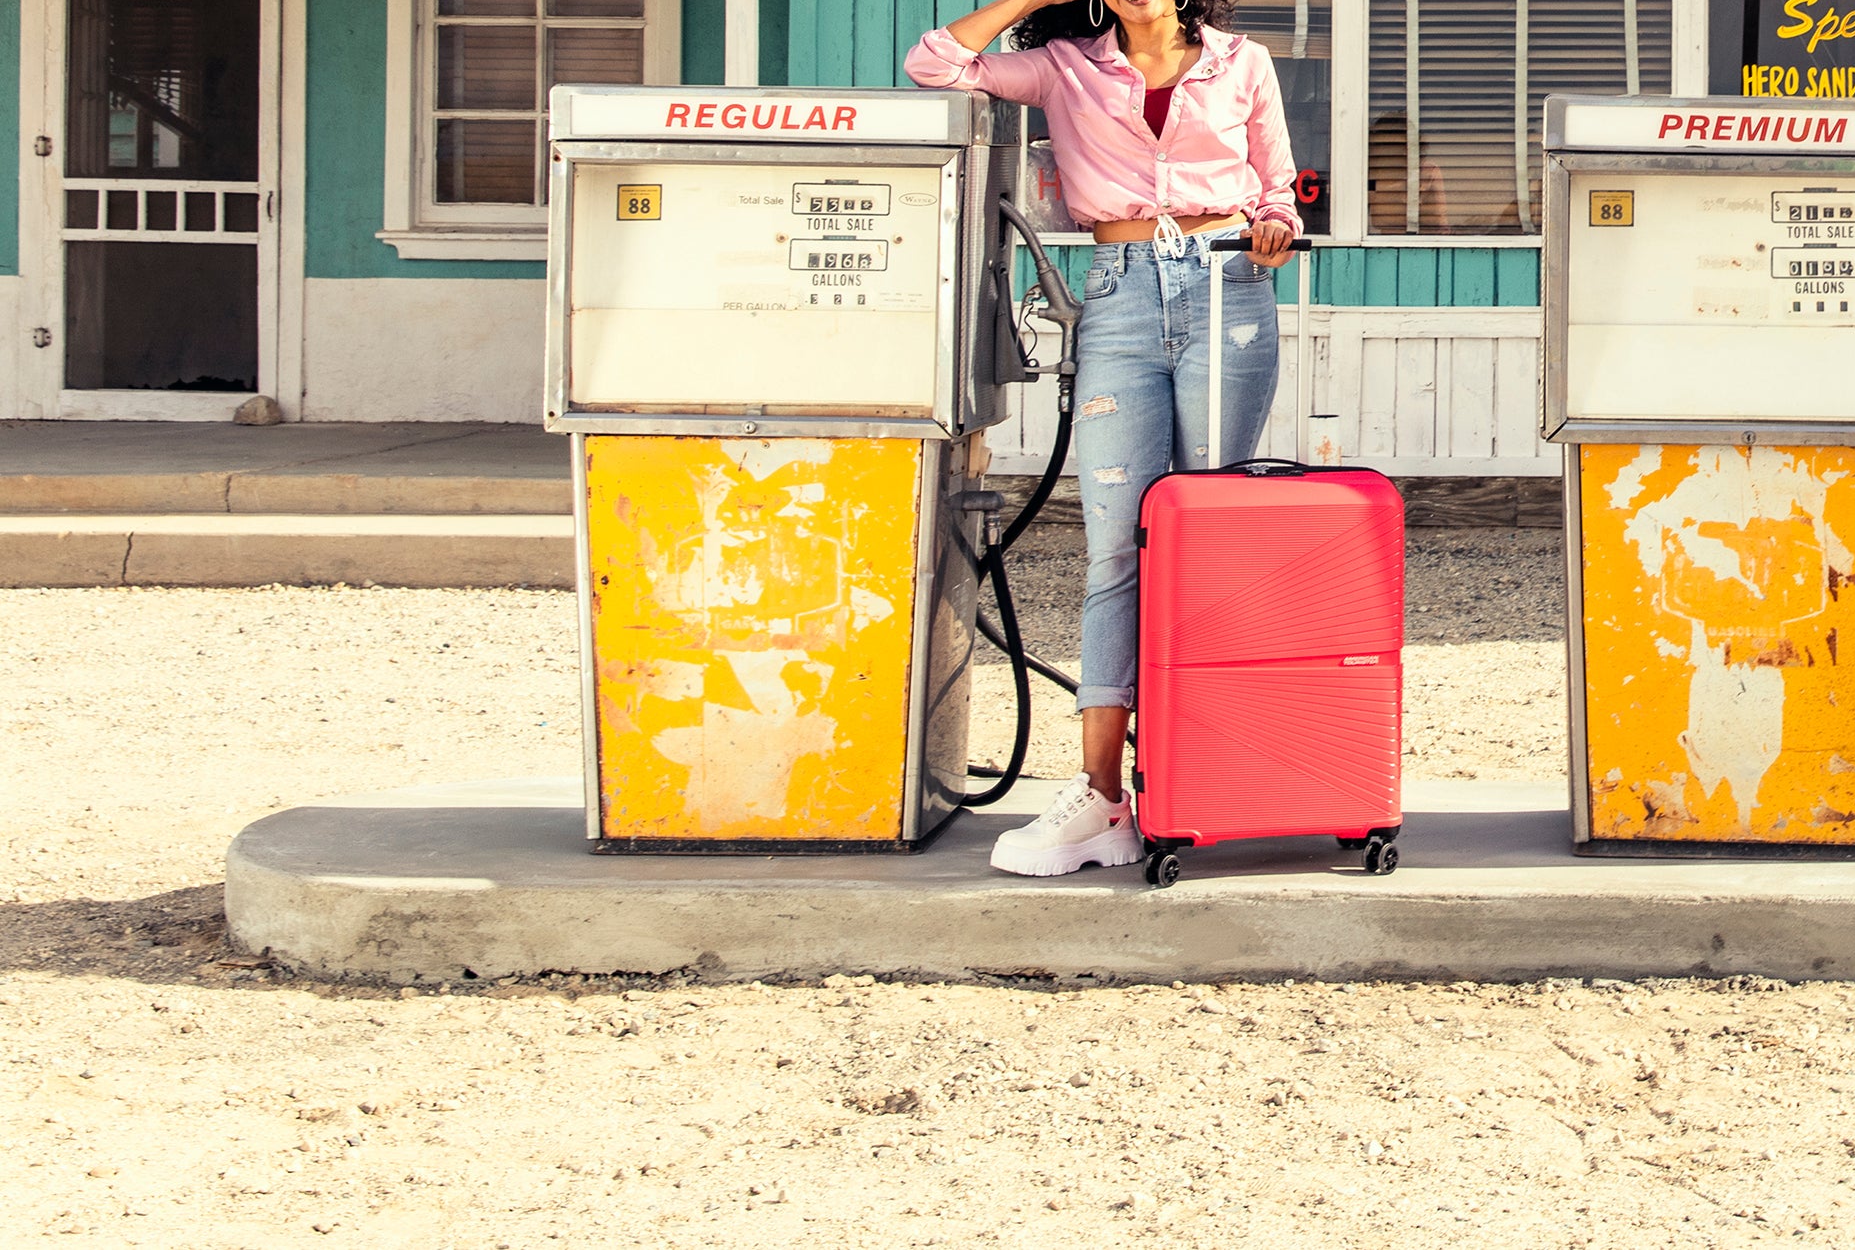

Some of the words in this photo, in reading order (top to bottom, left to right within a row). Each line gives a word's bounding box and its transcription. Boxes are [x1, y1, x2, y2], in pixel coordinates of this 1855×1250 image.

[1742, 64, 1800, 97] HERO
[665, 103, 857, 131] REGULAR
[1658, 113, 1848, 143] PREMIUM
[628, 198, 650, 214] 88
[739, 195, 761, 205] Total
[763, 196, 785, 205] Sale
[1601, 204, 1623, 220] 88
[806, 218, 841, 231] TOTAL
[846, 218, 875, 231] SALE
[1787, 225, 1821, 239] TOTAL
[1826, 225, 1855, 239] SALE
[811, 273, 862, 287] GALLONS
[1794, 280, 1845, 295] GALLONS
[723, 302, 743, 311] PER
